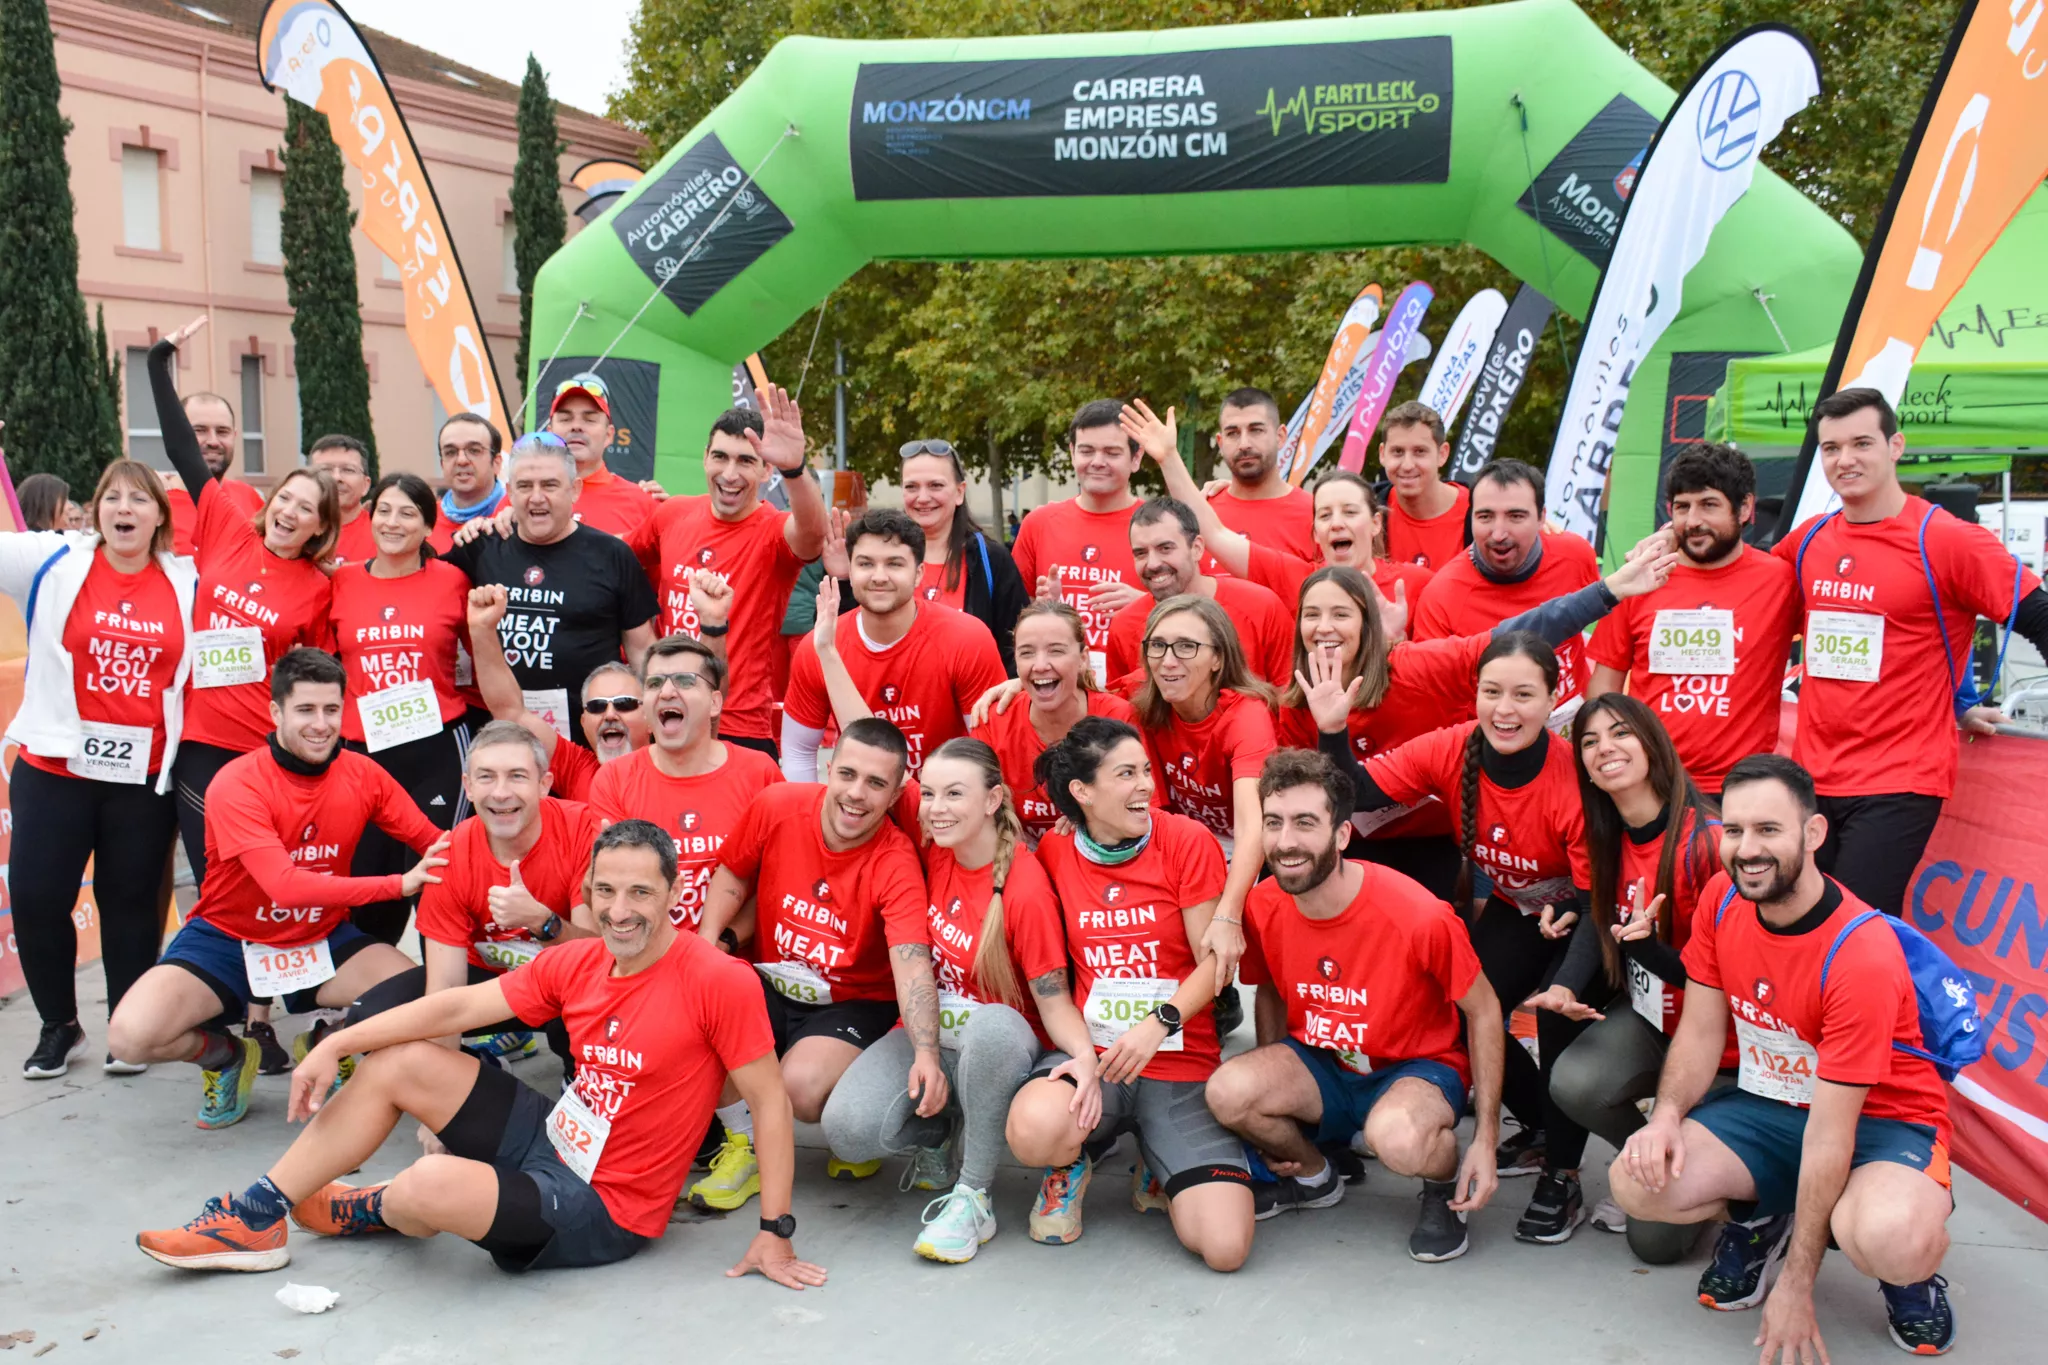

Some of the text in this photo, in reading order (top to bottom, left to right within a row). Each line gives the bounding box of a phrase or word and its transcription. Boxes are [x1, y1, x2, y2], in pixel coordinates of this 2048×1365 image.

[1073, 75, 1204, 102] CARRERA
[1314, 81, 1416, 104] FARTLECK
[863, 93, 1031, 124] MONZÓNCM
[1064, 102, 1218, 130] EMPRESAS
[1319, 109, 1416, 134] SPORT
[1054, 129, 1227, 161] MONZÓN CM
[625, 168, 712, 248] Automóviles
[645, 164, 744, 253] CABRERO
[1437, 340, 1477, 417] ORTISTAS
[1902, 374, 1952, 407] leck
[1057, 565, 1121, 583] FRIBIN
[668, 590, 694, 611] ME
[1813, 579, 1875, 602] FRIBIN
[213, 585, 279, 627] FRIBIN
[95, 611, 164, 635] FRIBIN
[497, 614, 561, 634] MEAT
[672, 609, 699, 629] YO
[356, 625, 424, 643] FRIBIN
[500, 631, 549, 649] YOU
[1659, 629, 1721, 648] 3049
[1814, 634, 1870, 656] 3054
[89, 637, 162, 664] MEAT
[197, 646, 251, 668] 3046
[505, 650, 553, 670] OVE
[1681, 648, 1721, 656] HECTOR
[1831, 655, 1868, 666] GERARD
[96, 656, 150, 678] YOU
[217, 664, 253, 673] MARINA
[360, 652, 423, 673] MEAT
[368, 670, 418, 690] YOU
[1671, 676, 1728, 696] YOU
[371, 696, 429, 728] 3053
[84, 737, 133, 760] 622
[86, 758, 131, 769] VERONICA
[1022, 799, 1061, 817] FRI
[1474, 843, 1539, 873] RIBIN
[783, 893, 848, 935] FRIBIN
[1079, 905, 1156, 929] FRIBIN
[1911, 859, 2048, 972] CUN
[774, 922, 844, 967] MEAT
[1083, 940, 1161, 968] MEAT
[259, 946, 319, 973] 1031
[277, 968, 310, 980] JAVIER
[1296, 982, 1368, 1006] FRIBIN
[1305, 1010, 1368, 1043] MEAT
[1748, 1045, 1812, 1078] 1024
[1760, 1070, 1804, 1086] JONATAN
[556, 1107, 592, 1154] 032
